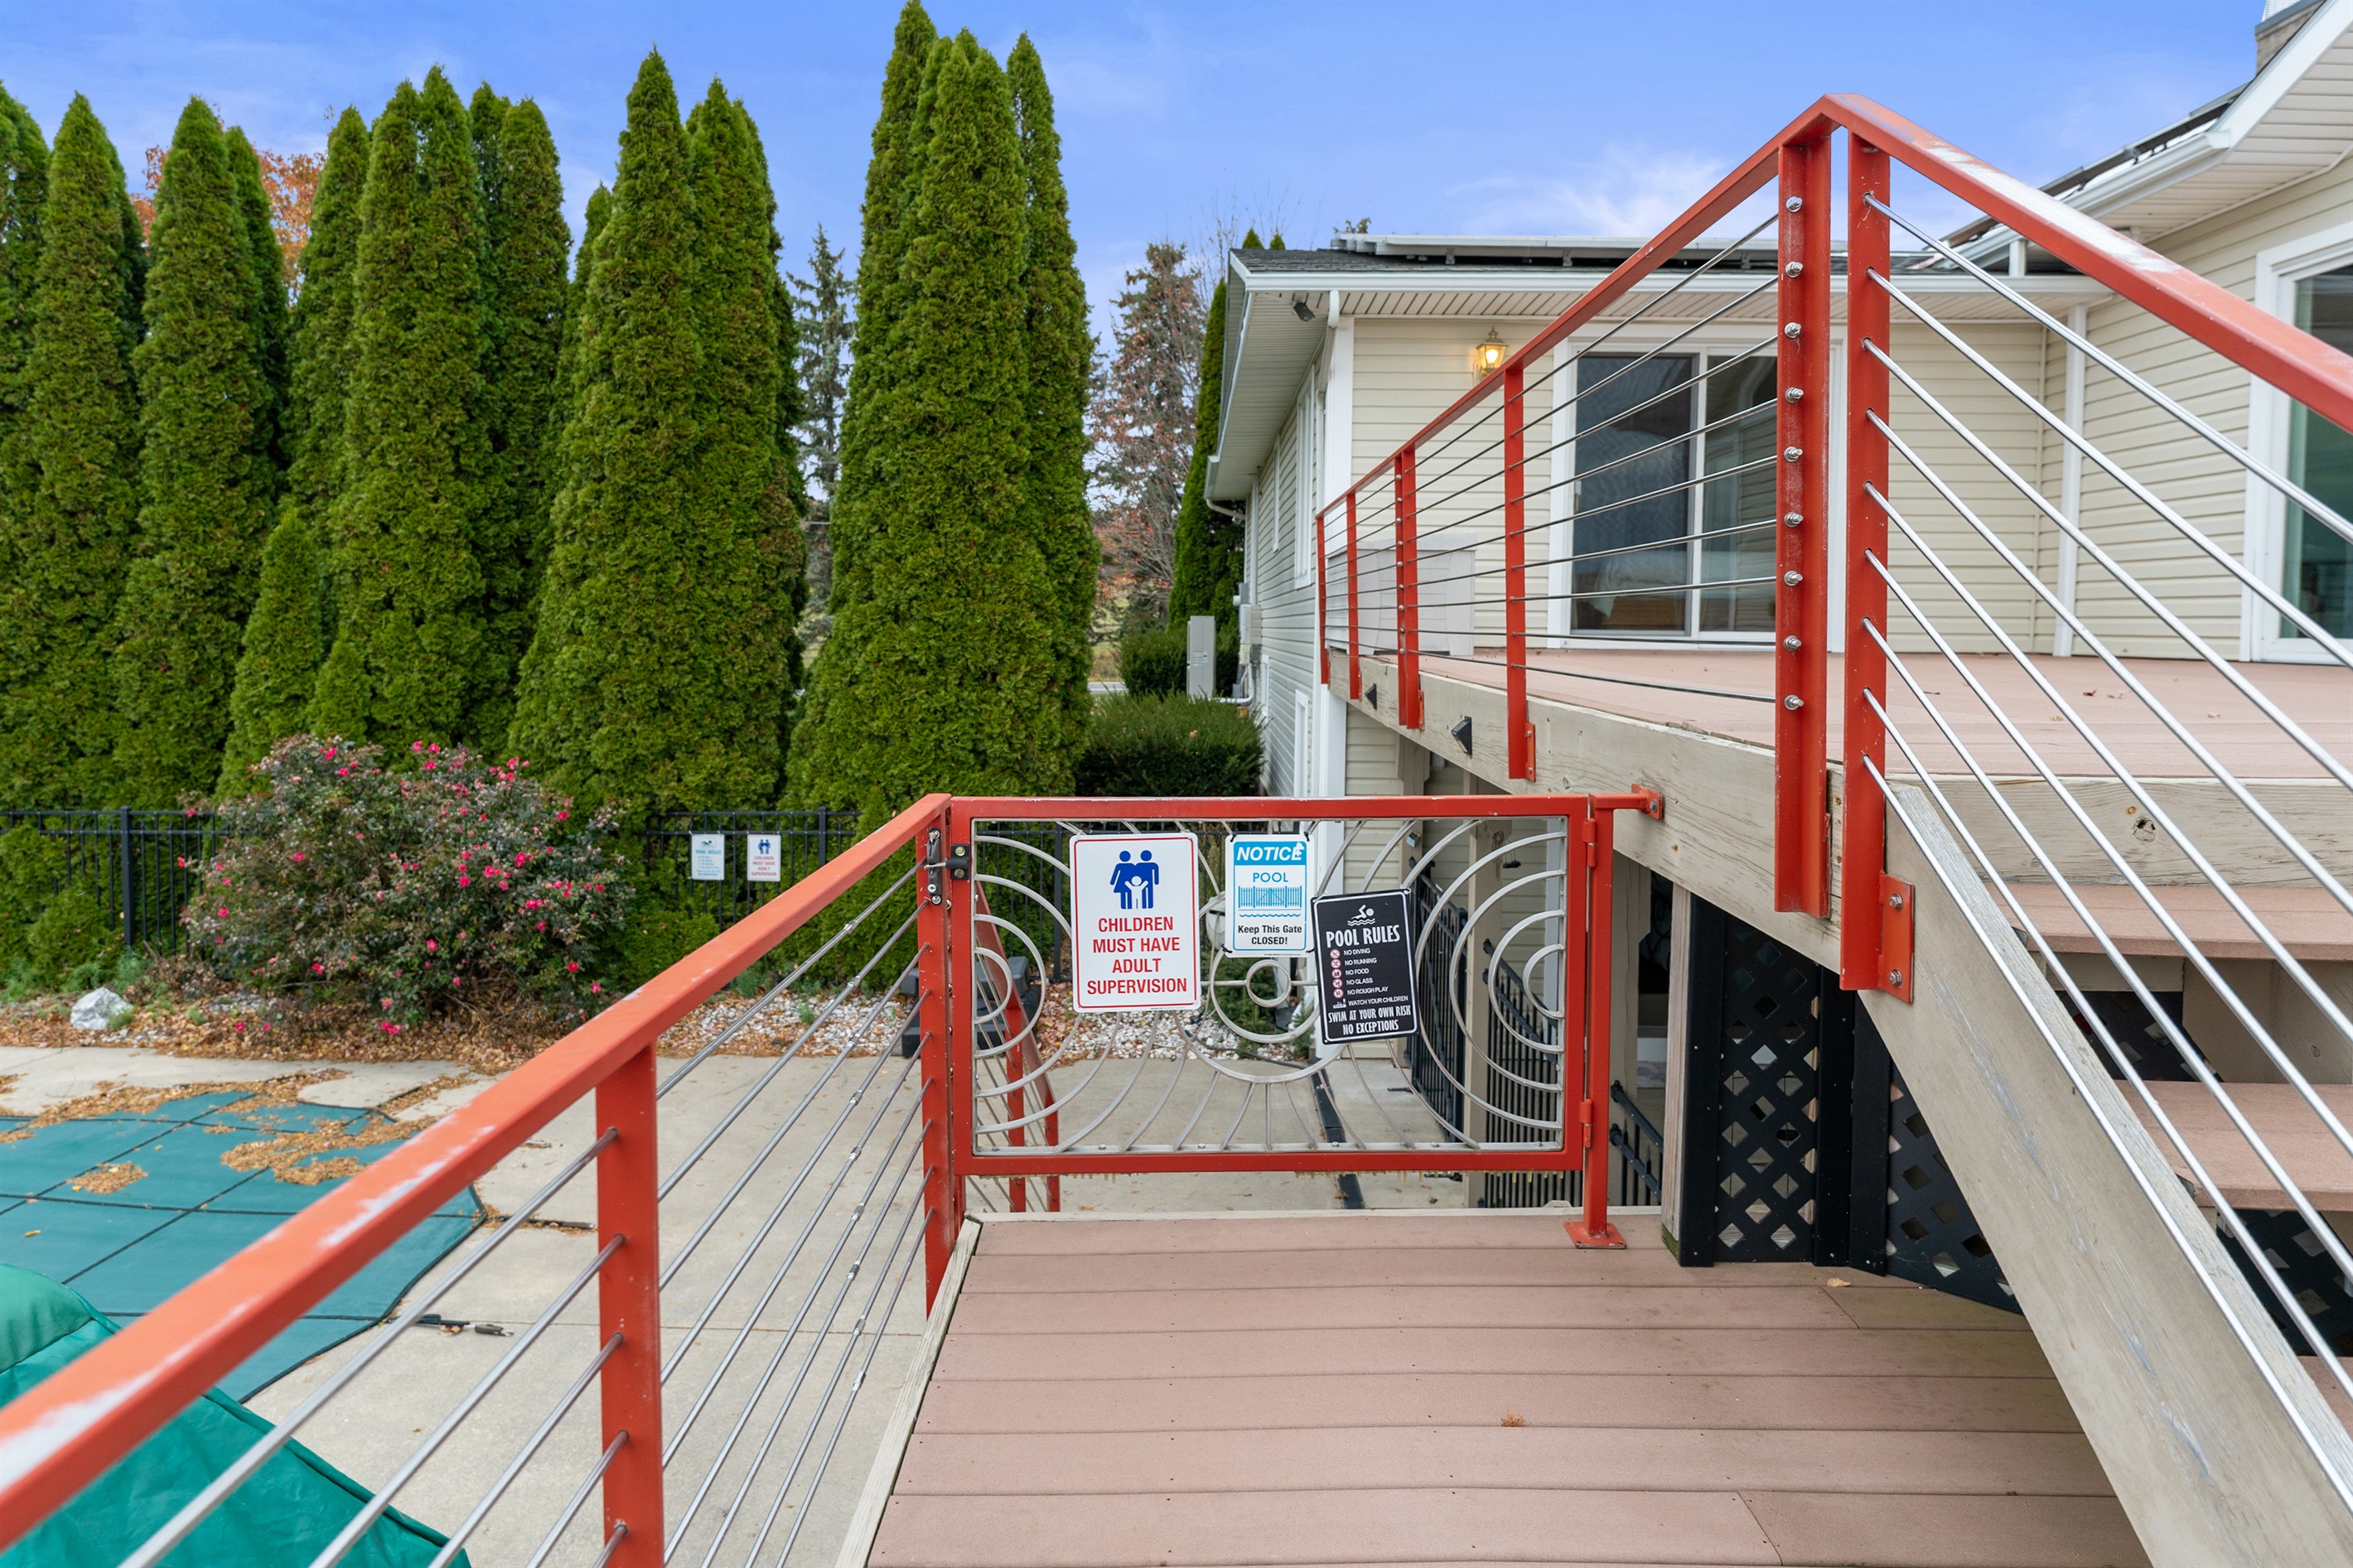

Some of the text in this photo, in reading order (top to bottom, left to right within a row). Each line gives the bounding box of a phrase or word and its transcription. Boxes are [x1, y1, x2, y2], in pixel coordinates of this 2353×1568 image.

[1237, 846, 1302, 861] NOTICE
[1253, 872, 1288, 883] POOL
[1098, 917, 1173, 932] CHILDREN
[1238, 925, 1259, 934] Keep
[1326, 925, 1400, 948] POOL RULES
[1093, 937, 1180, 953] MUST HAVE
[1112, 958, 1161, 973] ADULT
[1087, 978, 1187, 994] SUPERVISION
[1328, 1005, 1411, 1023] SWIM AT YOUR OWN RISK
[1343, 1019, 1399, 1035] NO EXCEPTIONS
